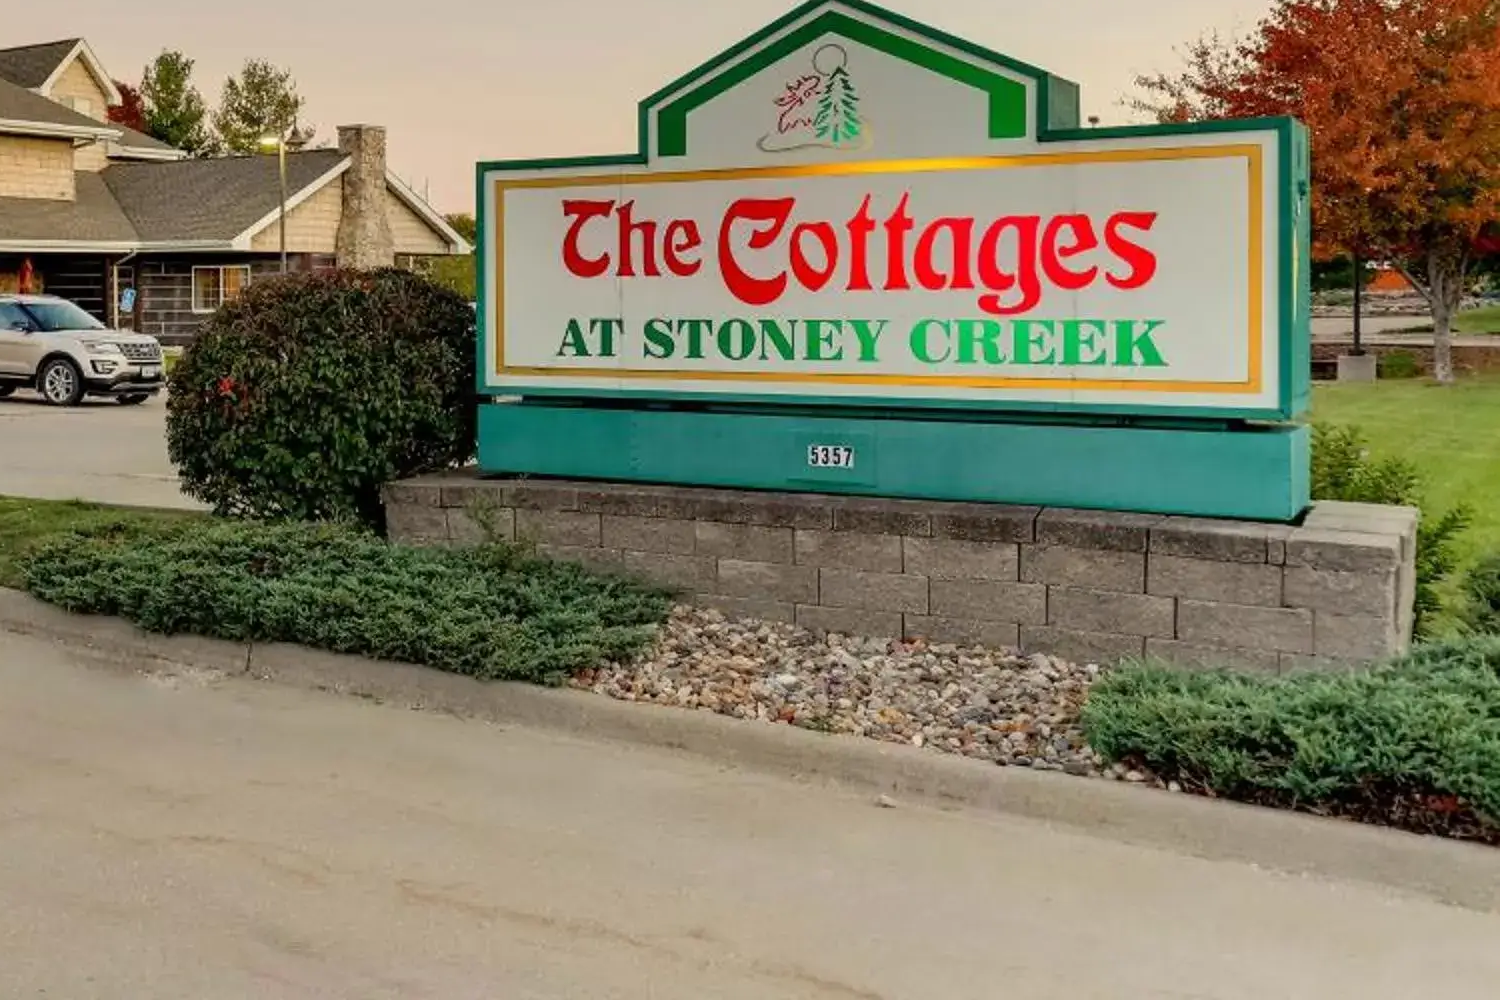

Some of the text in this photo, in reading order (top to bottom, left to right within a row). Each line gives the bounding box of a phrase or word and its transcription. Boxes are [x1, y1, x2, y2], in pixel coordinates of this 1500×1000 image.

[562, 191, 1158, 314] The Cottages
[556, 317, 1169, 368] AT STONEY CREEK
[811, 446, 853, 467] 5357
